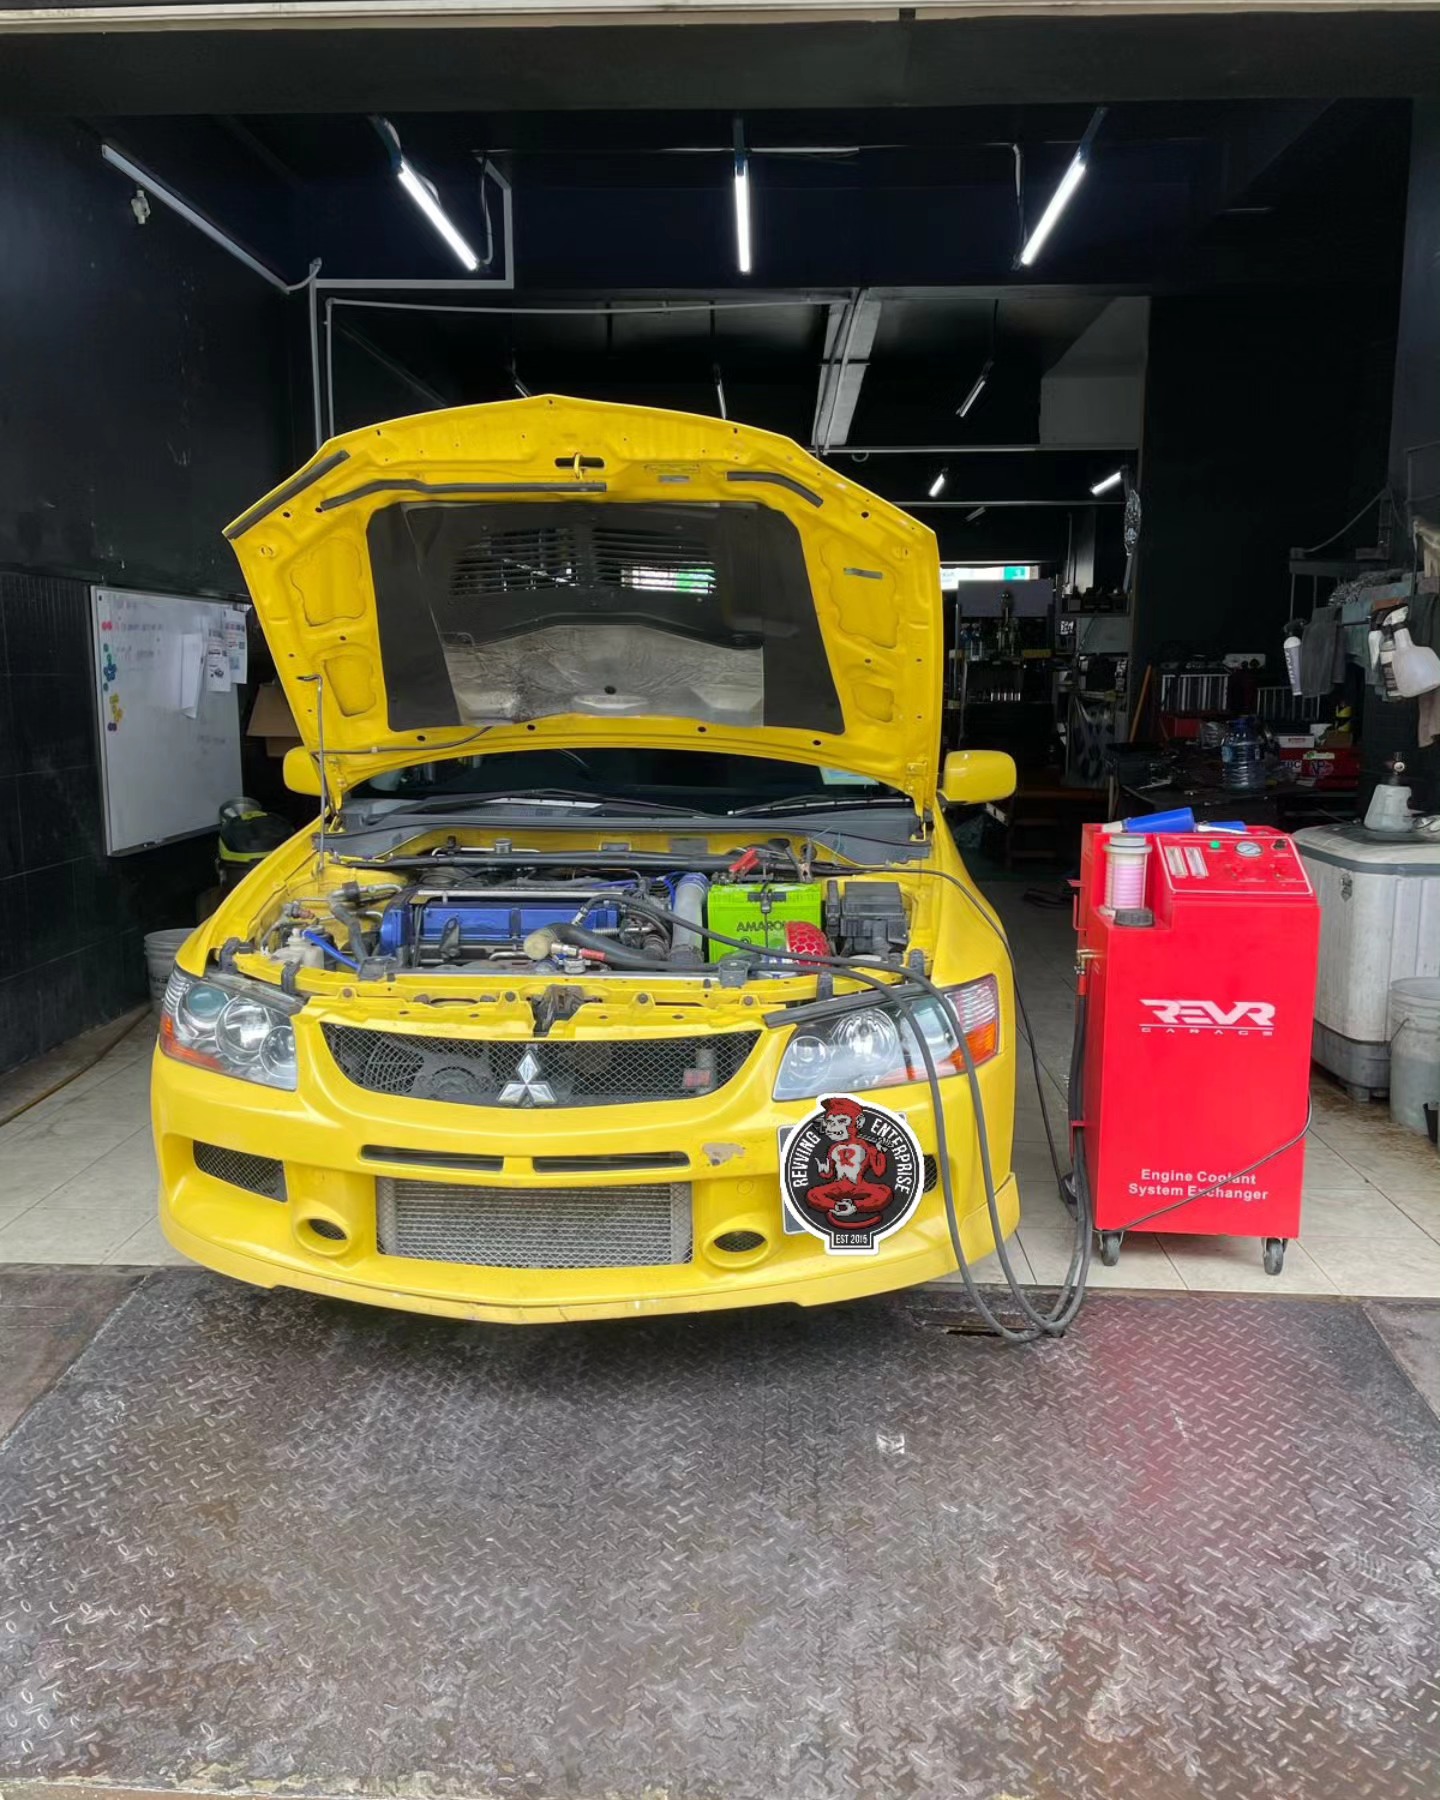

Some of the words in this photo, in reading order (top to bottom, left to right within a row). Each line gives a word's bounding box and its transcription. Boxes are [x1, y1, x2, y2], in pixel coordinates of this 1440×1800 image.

[1139, 999, 1276, 1026] REVR
[1141, 1168, 1193, 1183] Engine
[1128, 1182, 1183, 1197] System
